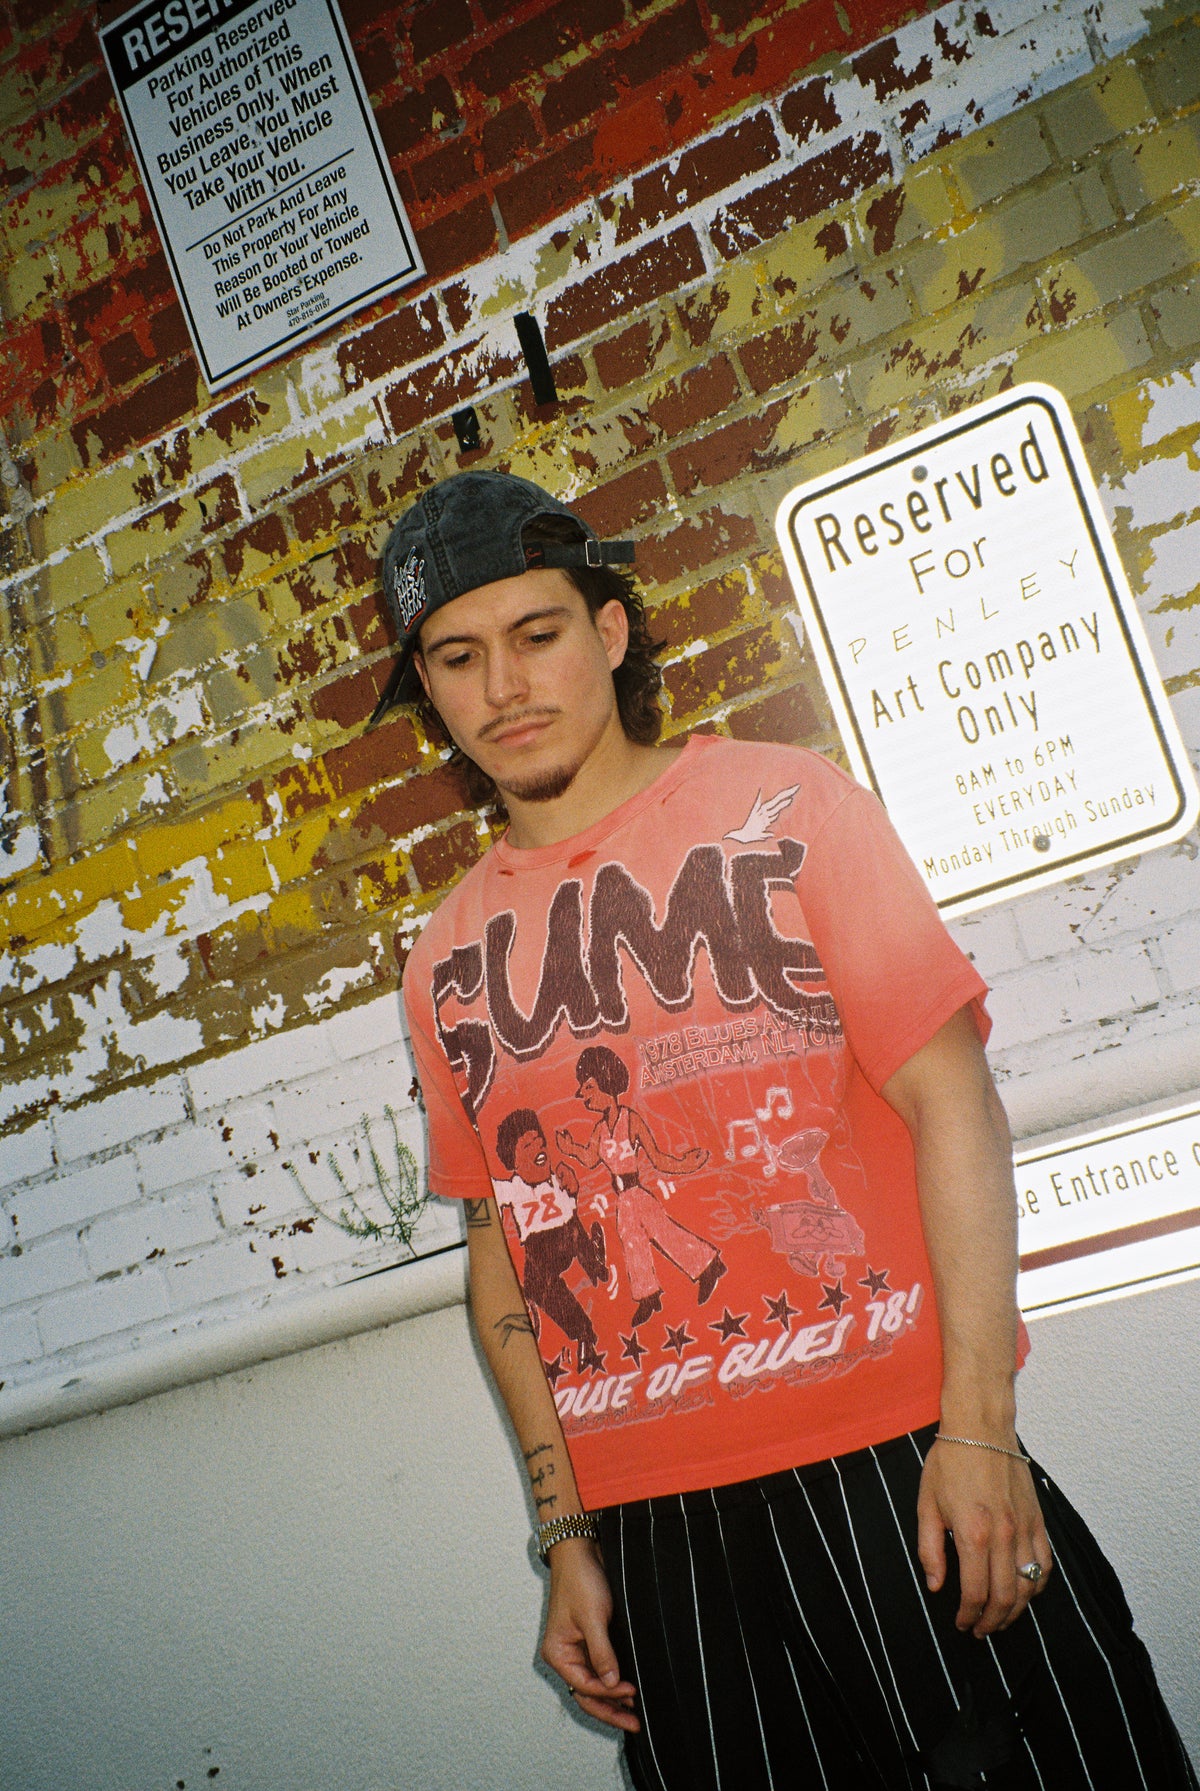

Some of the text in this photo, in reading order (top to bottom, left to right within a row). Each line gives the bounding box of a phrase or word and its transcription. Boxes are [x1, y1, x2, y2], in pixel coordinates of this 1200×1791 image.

[147, 46, 214, 99] Parking
[167, 18, 291, 114] For Authorized
[169, 44, 303, 138] Vehicles of This
[157, 53, 333, 175] Business Only. When
[164, 166, 198, 195] You
[255, 108, 290, 137] You
[290, 75, 340, 117] Must
[183, 109, 333, 210] Take Your Vehicle
[203, 166, 347, 260] Do Not Park And Leave
[223, 157, 306, 213] With You.
[212, 187, 348, 275] This Property For Any
[213, 204, 360, 298] Reason Or Your Vehicle
[215, 218, 371, 318] Will Be Booted or Towed
[236, 250, 363, 331] At Owners Expense.
[286, 292, 325, 318] Star Parking
[813, 420, 1050, 573] Reserved
[848, 548, 1078, 664] PENLEY
[908, 536, 987, 594] For
[871, 611, 1101, 728] Art Company
[957, 690, 1039, 745] Only
[955, 734, 1075, 796] 8AM to 6PM
[973, 768, 1078, 826] EVERYDAY
[923, 783, 1156, 880] Monday Through Sunday
[639, 1032, 683, 1067] 1978
[760, 1031, 795, 1056] NL
[522, 1192, 563, 1229] 78
[1049, 1150, 1180, 1207] Entrance
[646, 1355, 714, 1401] OF
[717, 1313, 855, 1385] BLUES
[865, 1282, 923, 1342] 78!
